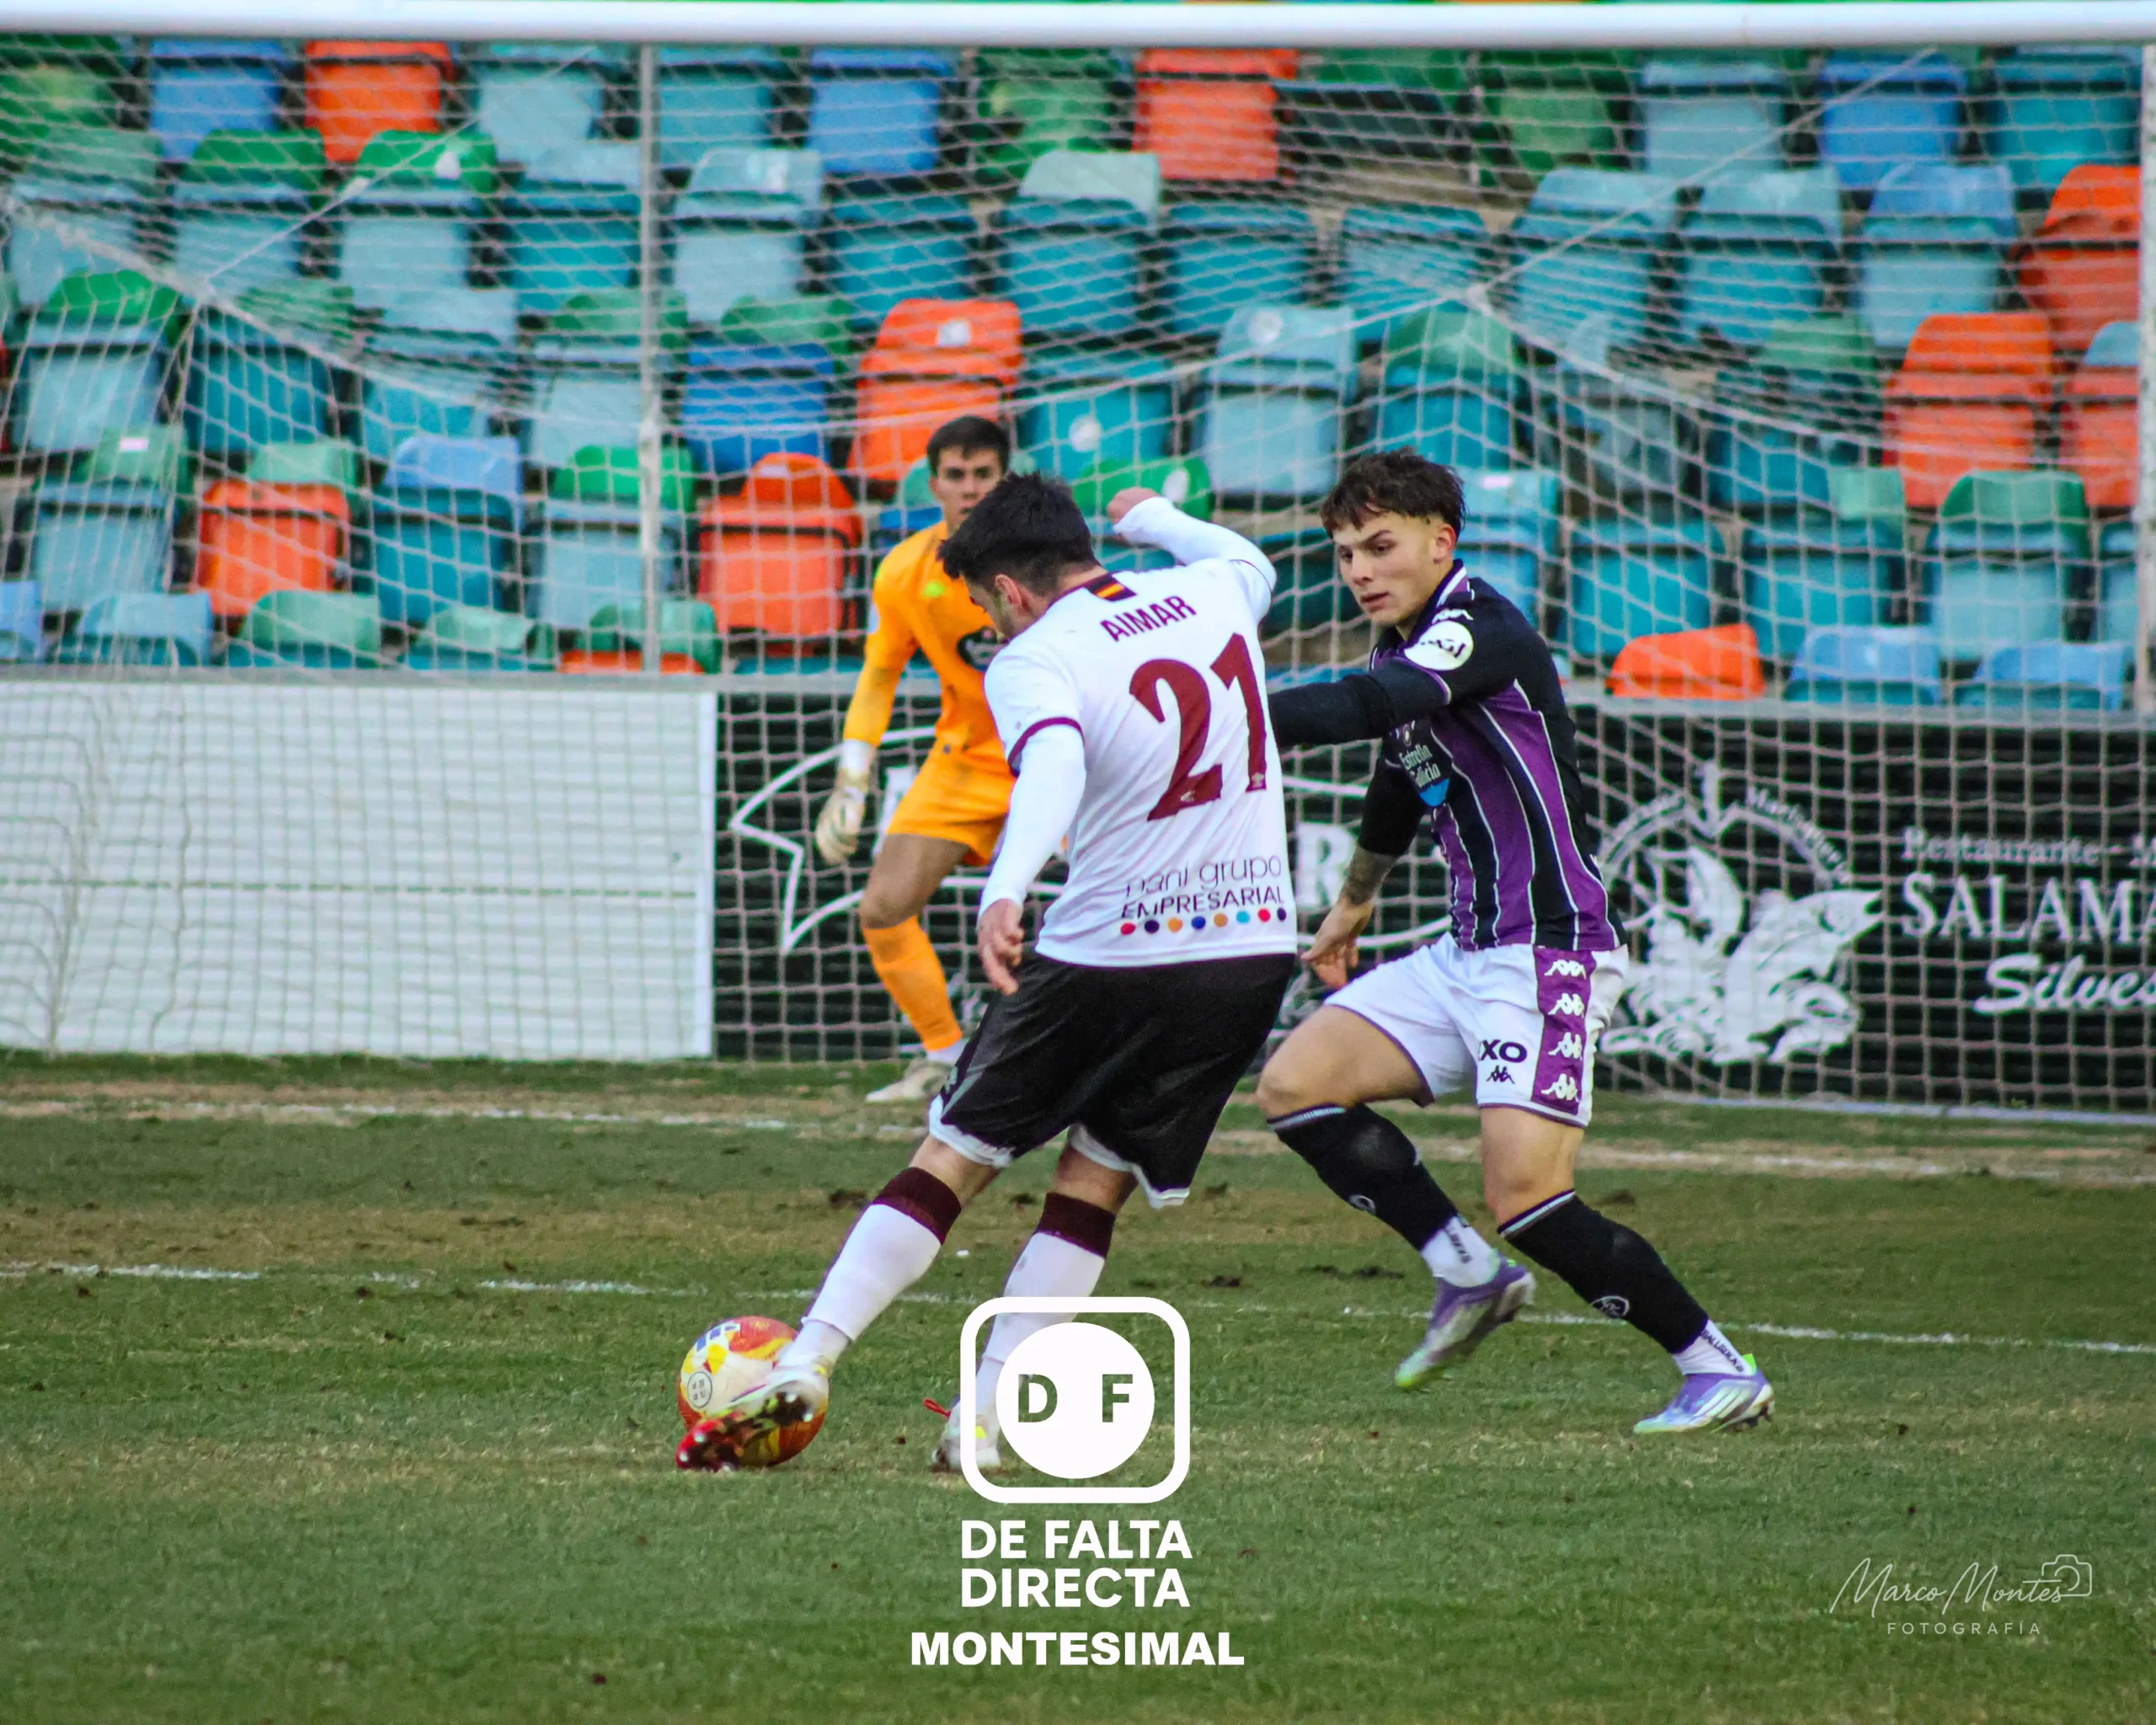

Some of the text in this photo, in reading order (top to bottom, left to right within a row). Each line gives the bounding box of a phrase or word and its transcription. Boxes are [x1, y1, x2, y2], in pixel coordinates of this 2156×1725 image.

[1100, 595, 1197, 642] AIMAR
[1129, 633, 1267, 822] 21
[1901, 826, 2100, 867] Restaurante
[1198, 855, 1282, 891] grupo
[1121, 885, 1285, 919] EMPRESARIAL
